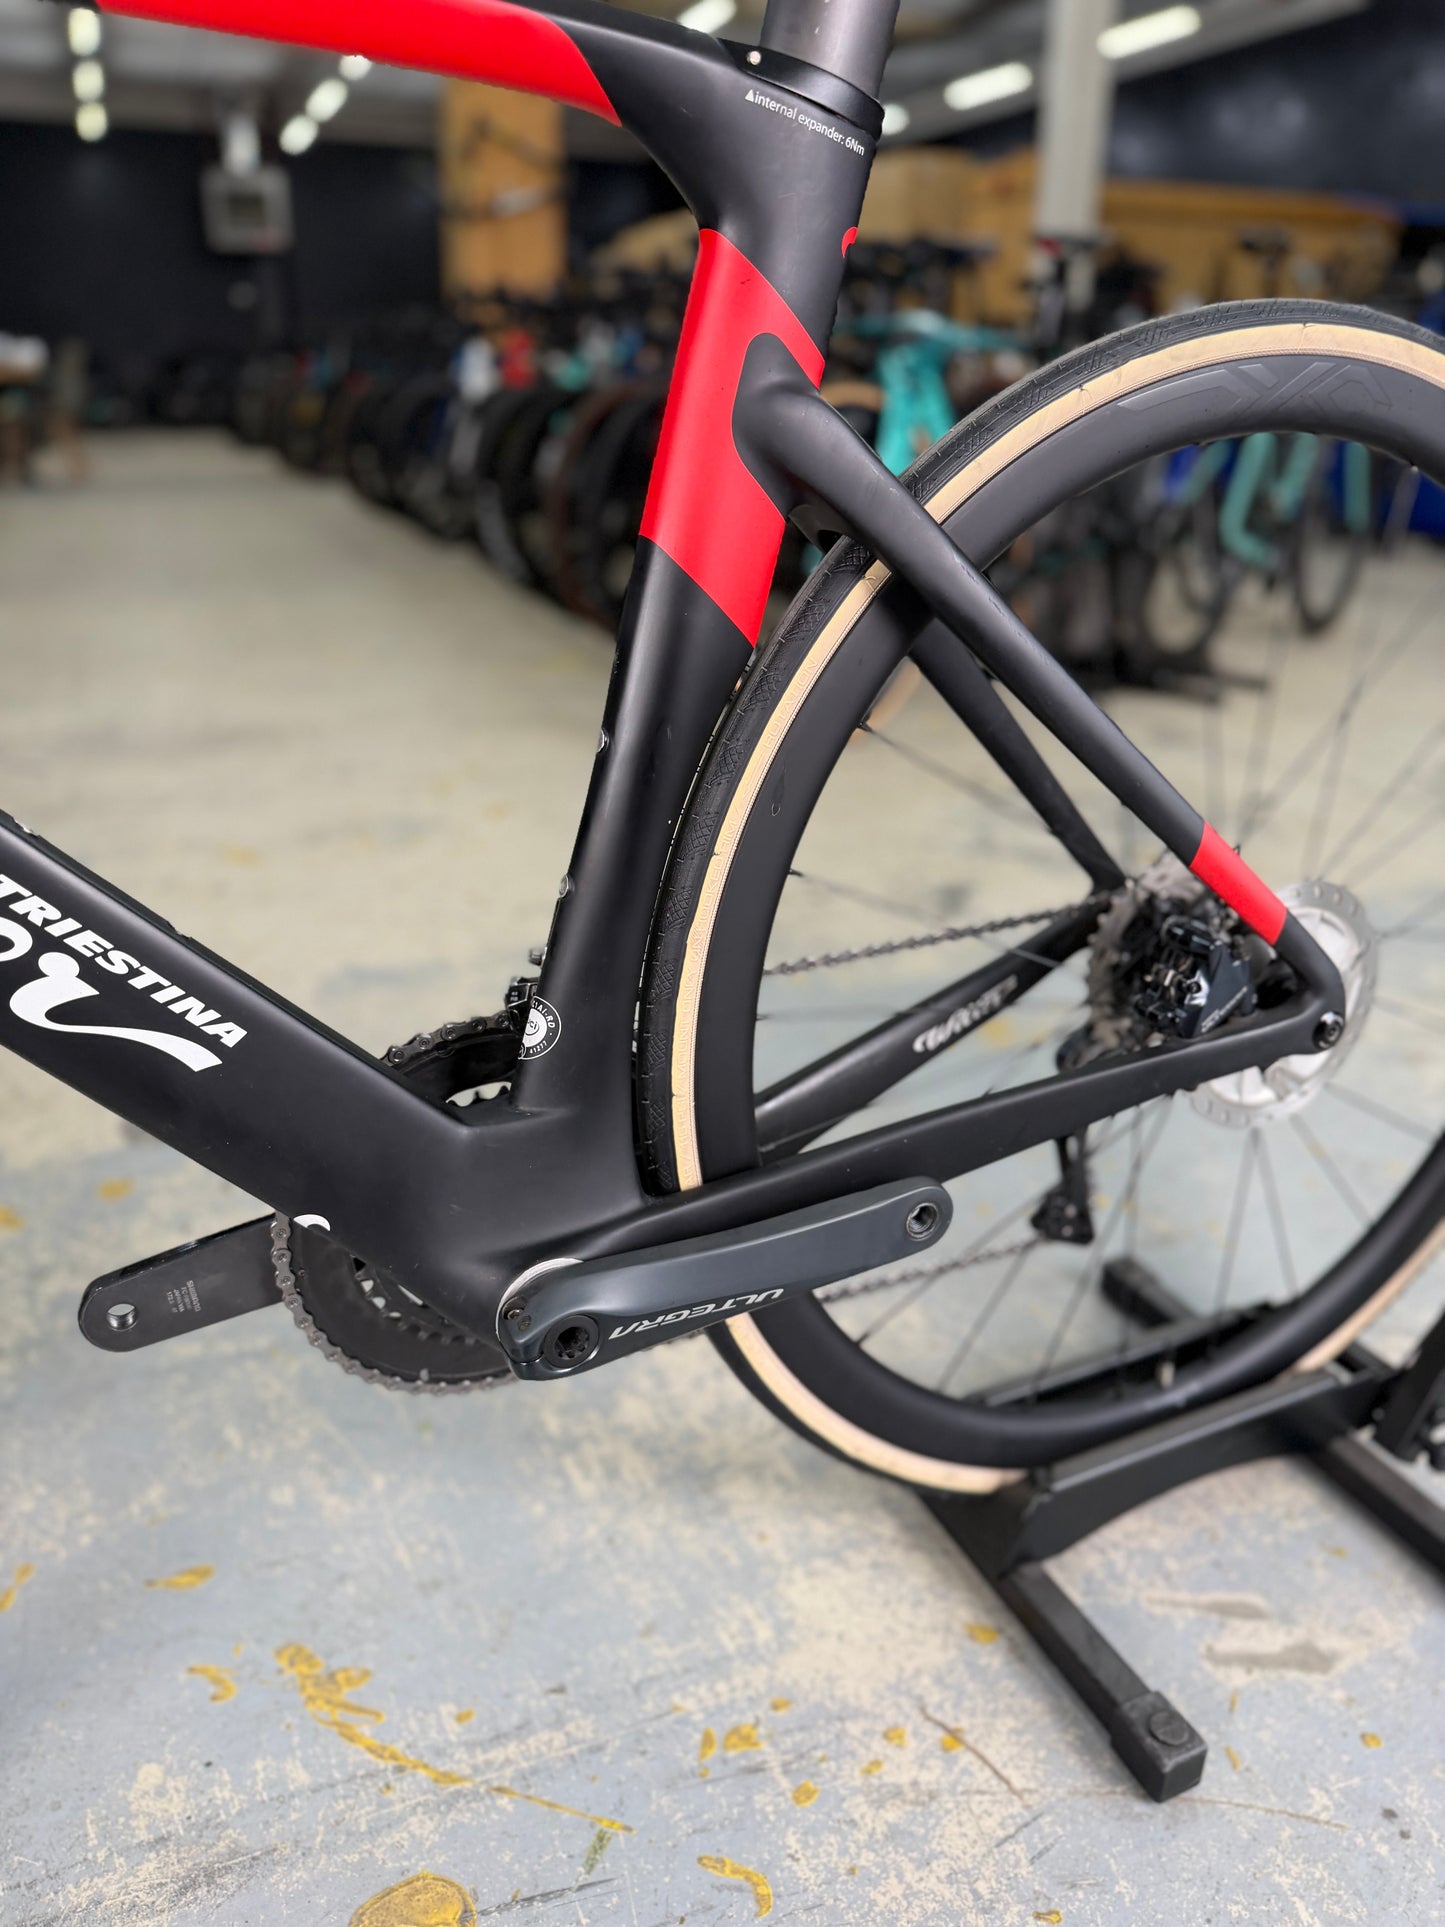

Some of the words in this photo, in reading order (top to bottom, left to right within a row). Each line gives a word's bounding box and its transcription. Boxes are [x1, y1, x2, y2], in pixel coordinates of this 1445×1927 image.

[754, 91, 797, 119] internal
[798, 114, 845, 145] expander:
[845, 136, 865, 156] 6Nm
[0, 873, 248, 1048] TRIESTINA
[608, 1288, 784, 1340] ULTEGRA
